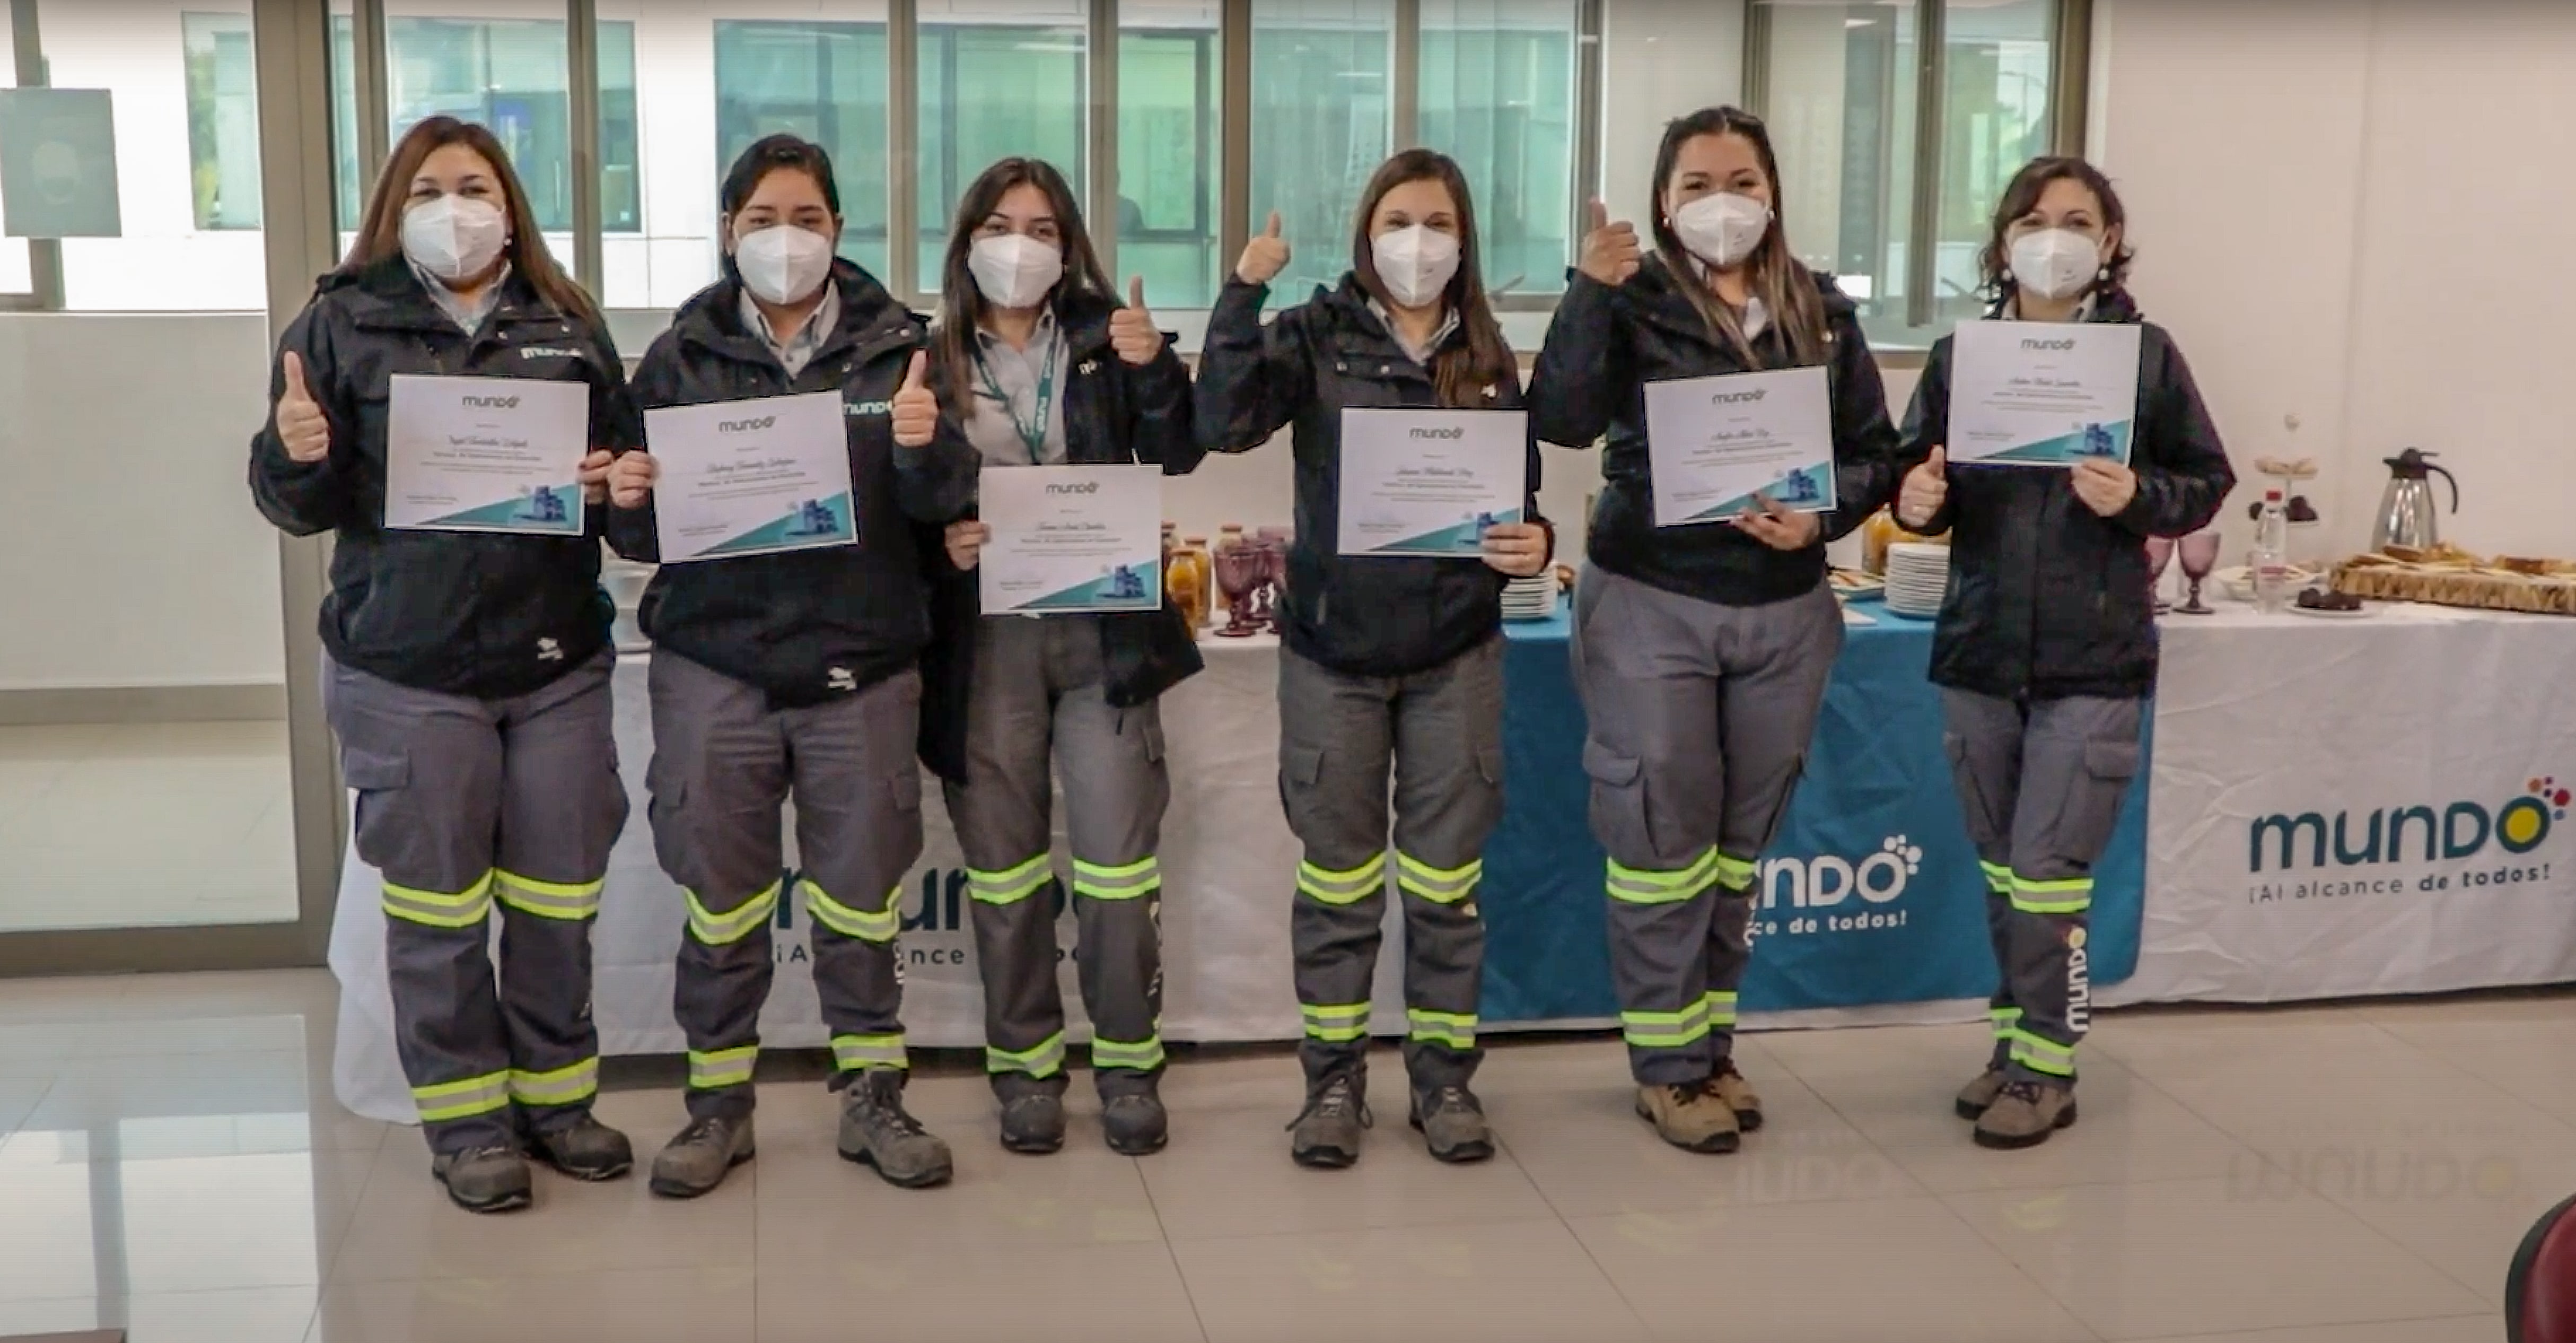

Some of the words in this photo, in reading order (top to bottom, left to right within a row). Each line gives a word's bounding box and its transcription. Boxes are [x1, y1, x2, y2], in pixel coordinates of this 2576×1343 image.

[2295, 879, 2403, 899] alcance
[2419, 874, 2448, 891] de
[2463, 862, 2550, 888] todos!
[1789, 917, 1818, 934] de
[1828, 909, 1907, 932] todos!
